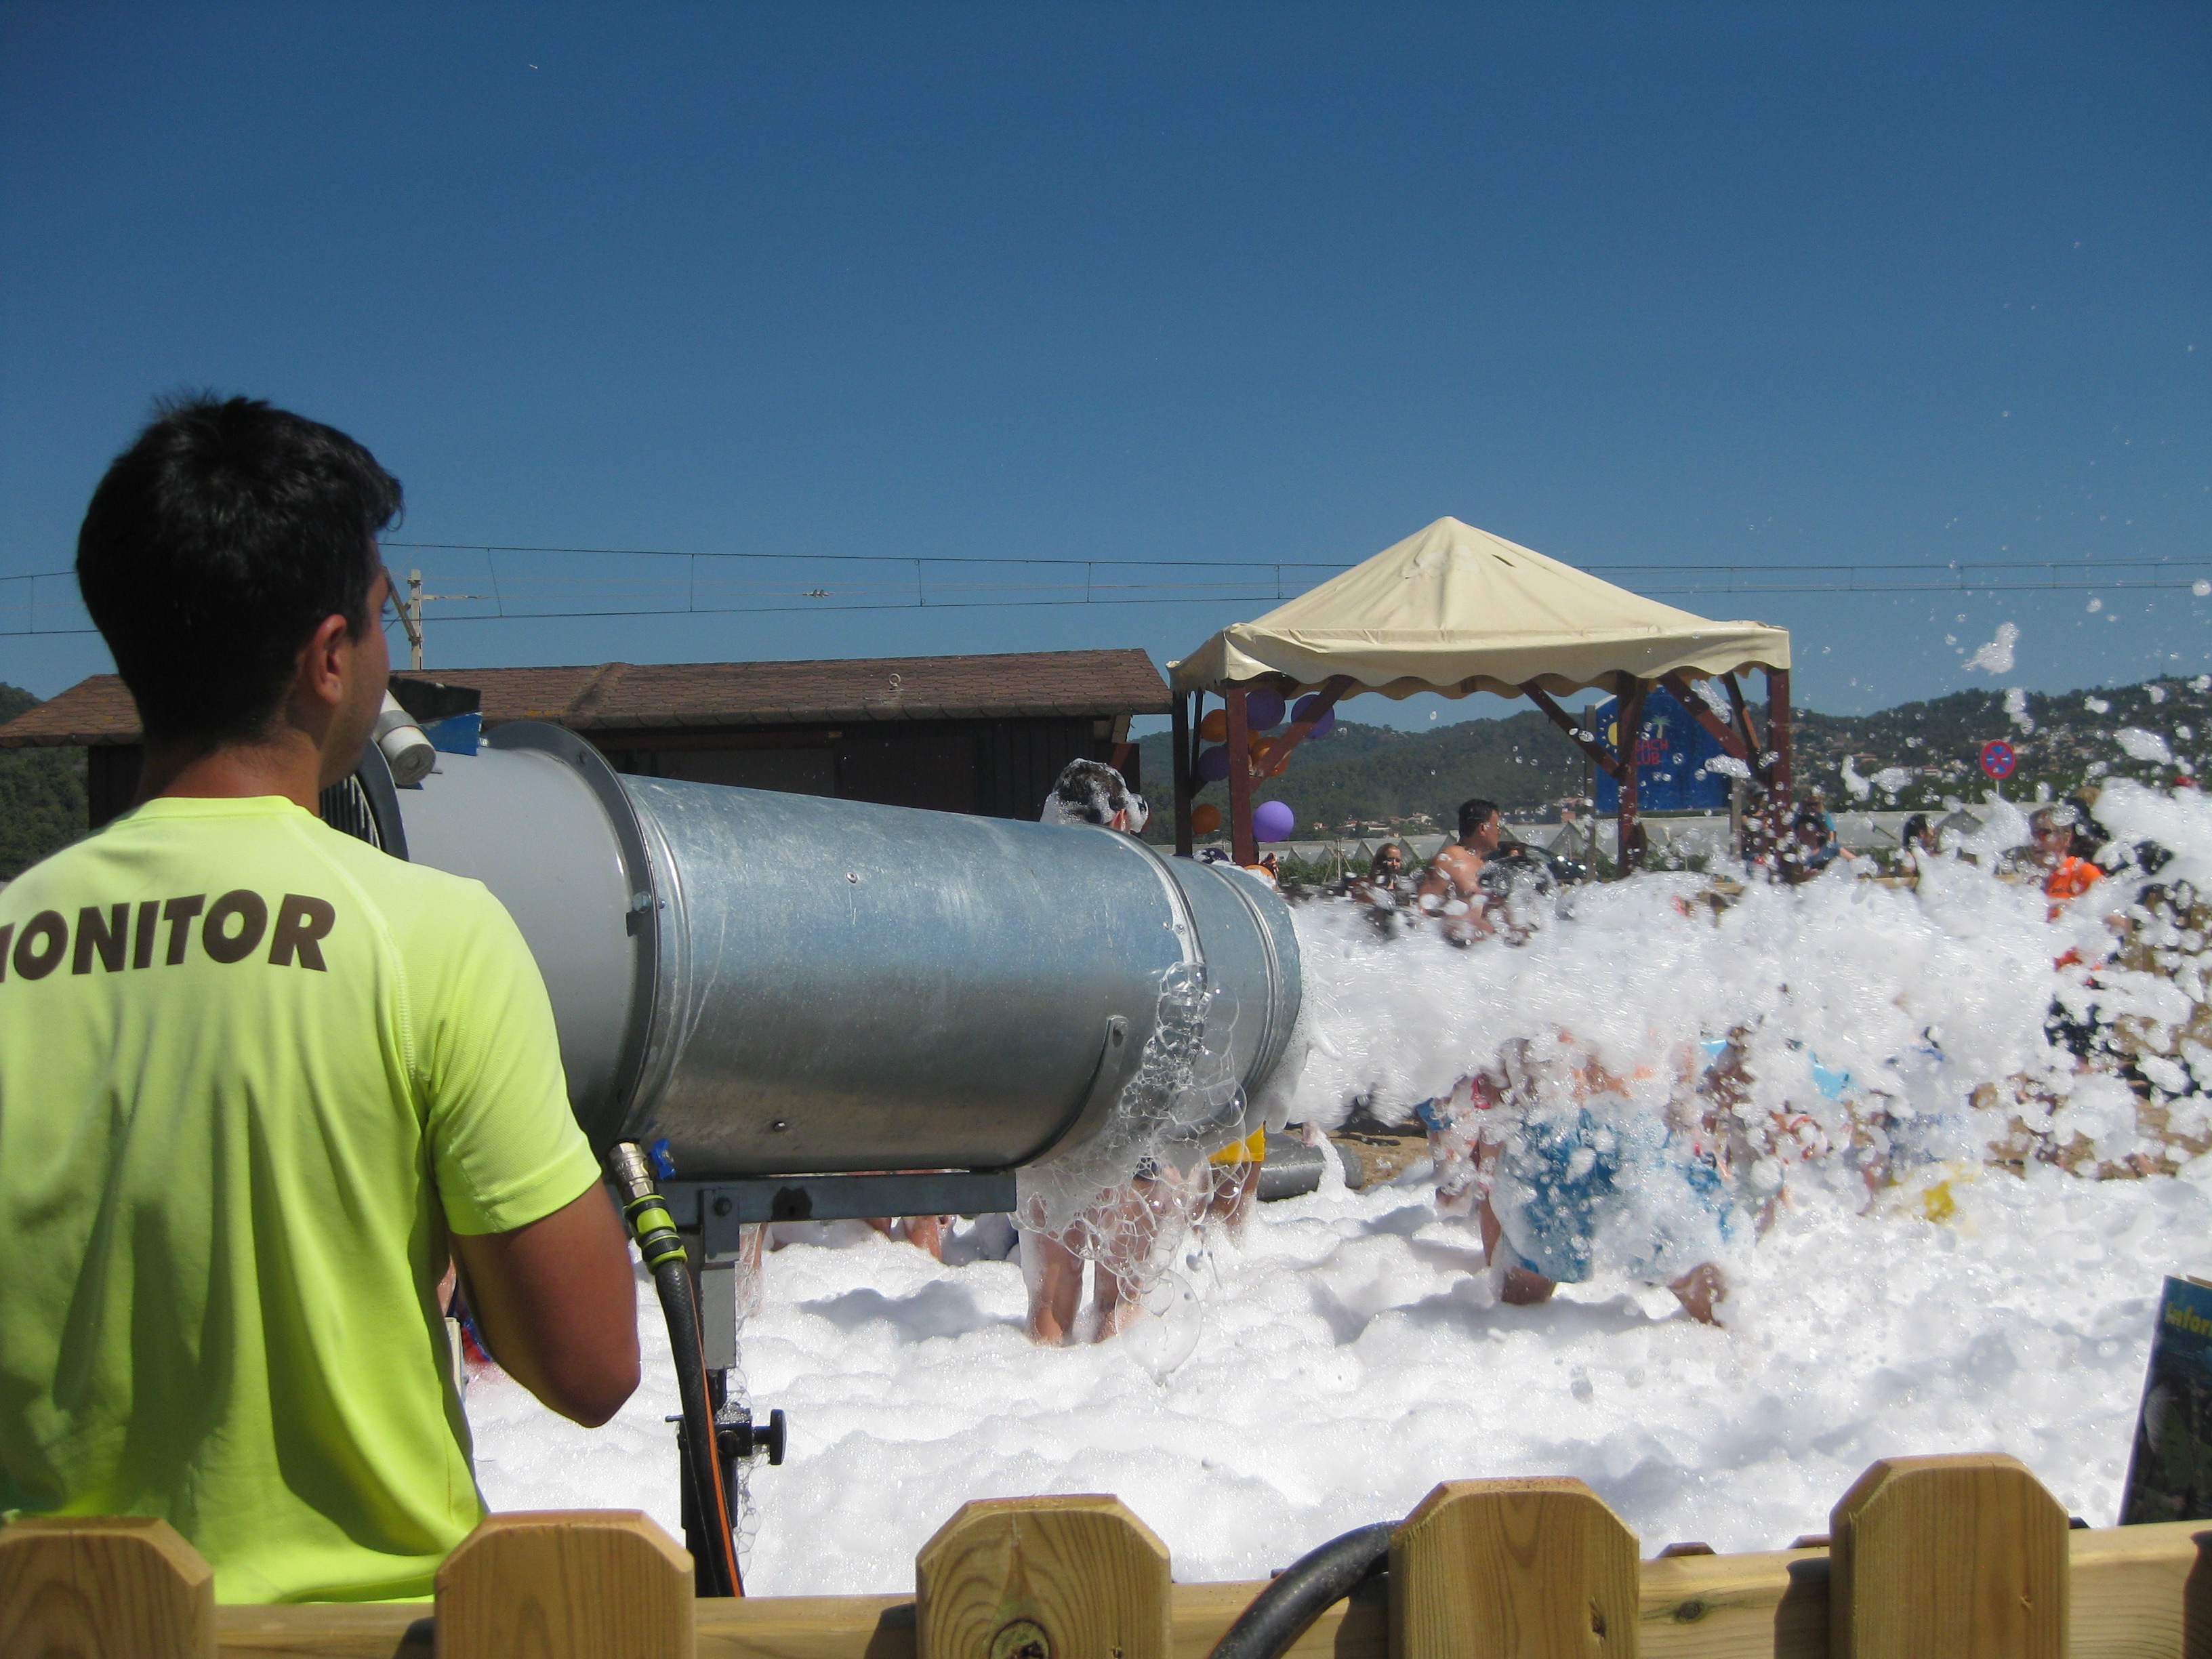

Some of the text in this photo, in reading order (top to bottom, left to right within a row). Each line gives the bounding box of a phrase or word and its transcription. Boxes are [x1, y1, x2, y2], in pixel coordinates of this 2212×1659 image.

[1635, 739, 1670, 752] EACH
[1634, 752, 1661, 765] LUB
[0, 888, 336, 983] ONITOR
